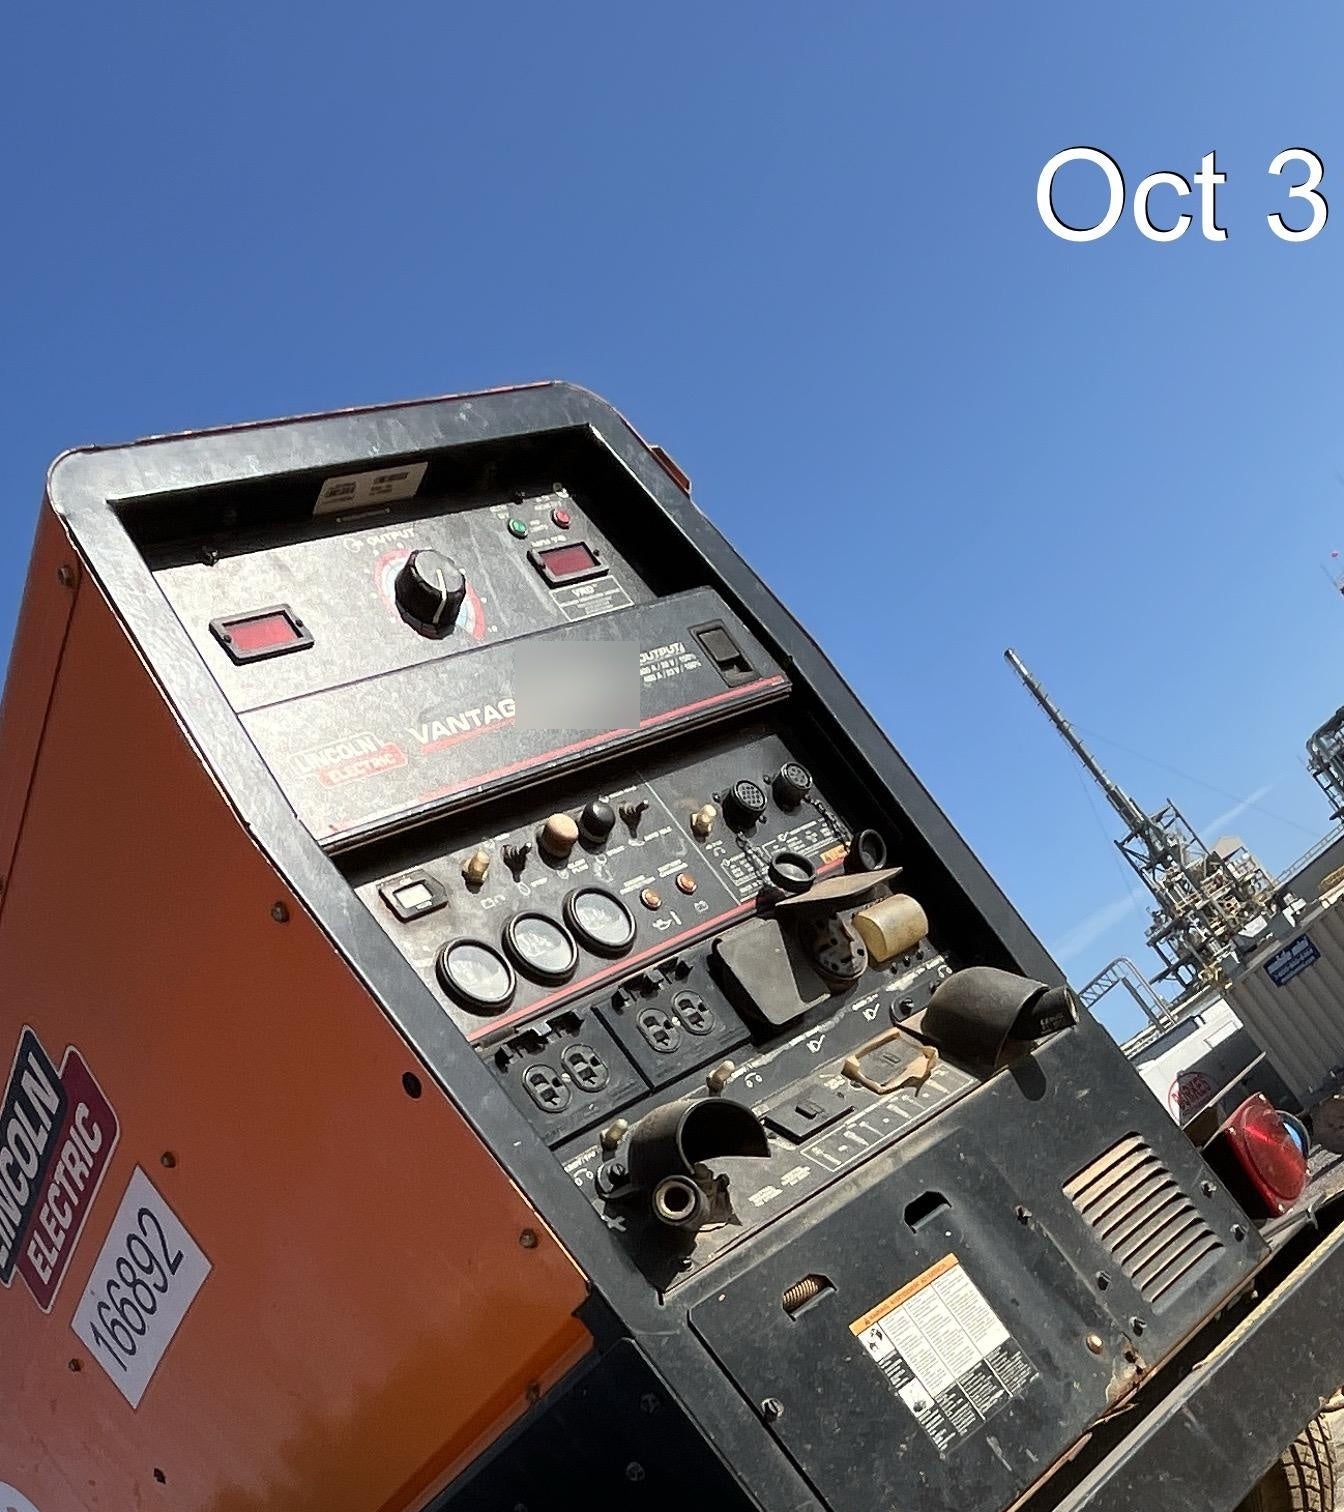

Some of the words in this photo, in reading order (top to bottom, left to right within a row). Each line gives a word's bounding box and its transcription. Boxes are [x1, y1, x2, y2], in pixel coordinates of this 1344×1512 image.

[408, 699, 516, 744] VANTAG
[27, 1102, 103, 1285] ELECTRIC
[90, 1207, 184, 1372] 166892
